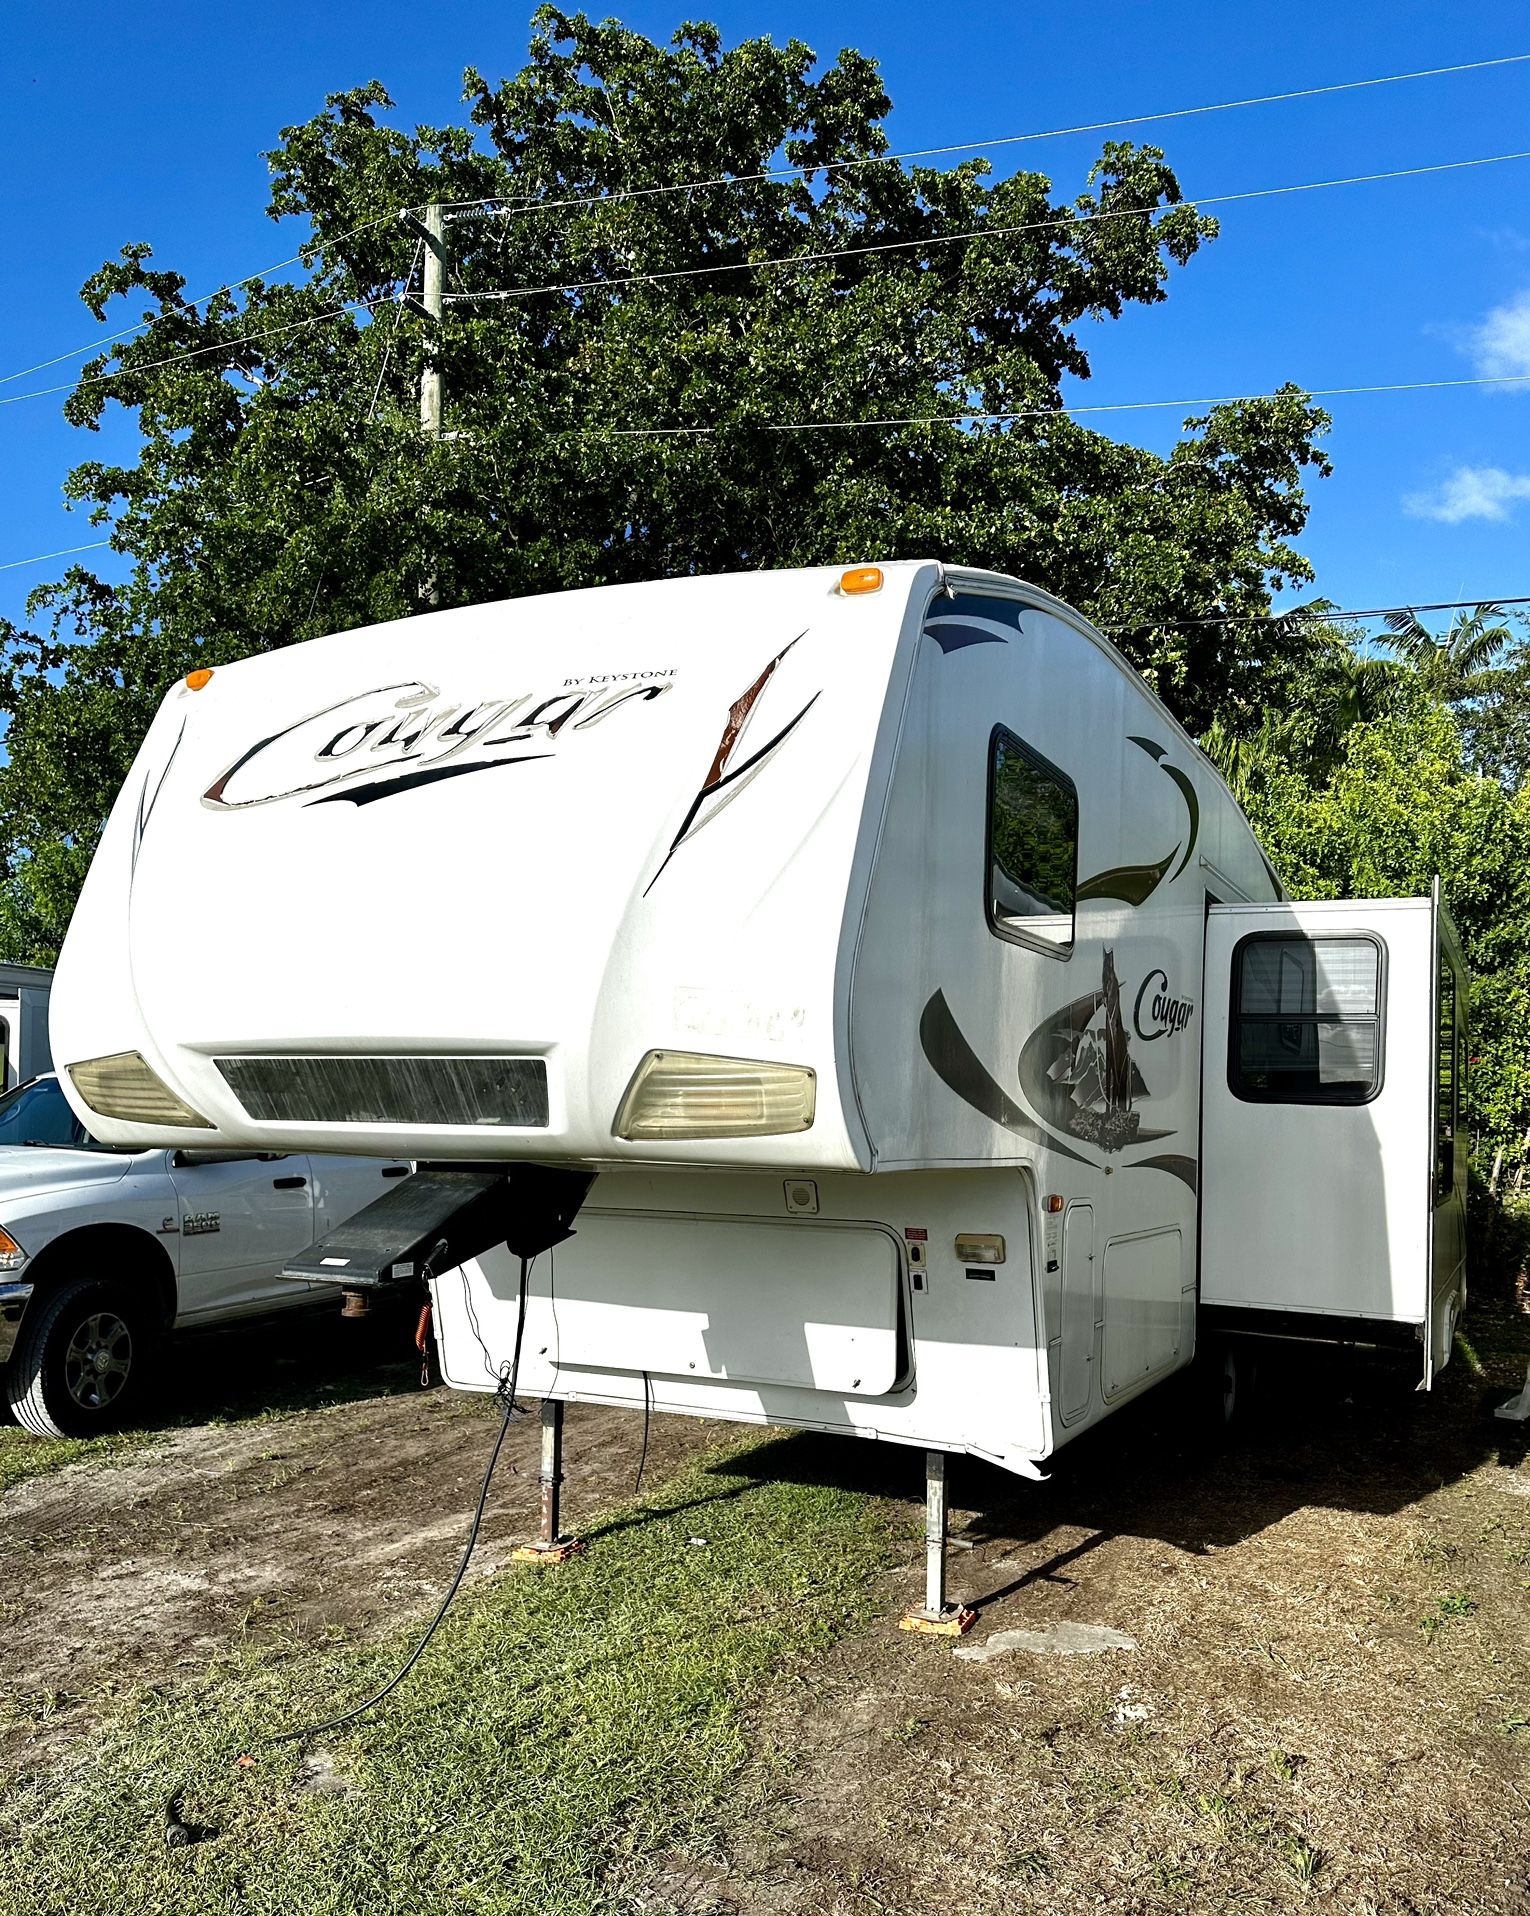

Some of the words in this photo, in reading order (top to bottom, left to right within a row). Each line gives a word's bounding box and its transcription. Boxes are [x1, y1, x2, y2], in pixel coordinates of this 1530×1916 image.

[563, 678, 585, 687] BY
[589, 669, 678, 684] KEYSTONE
[200, 681, 673, 811] Cougar
[1133, 969, 1194, 1041] Cougar
